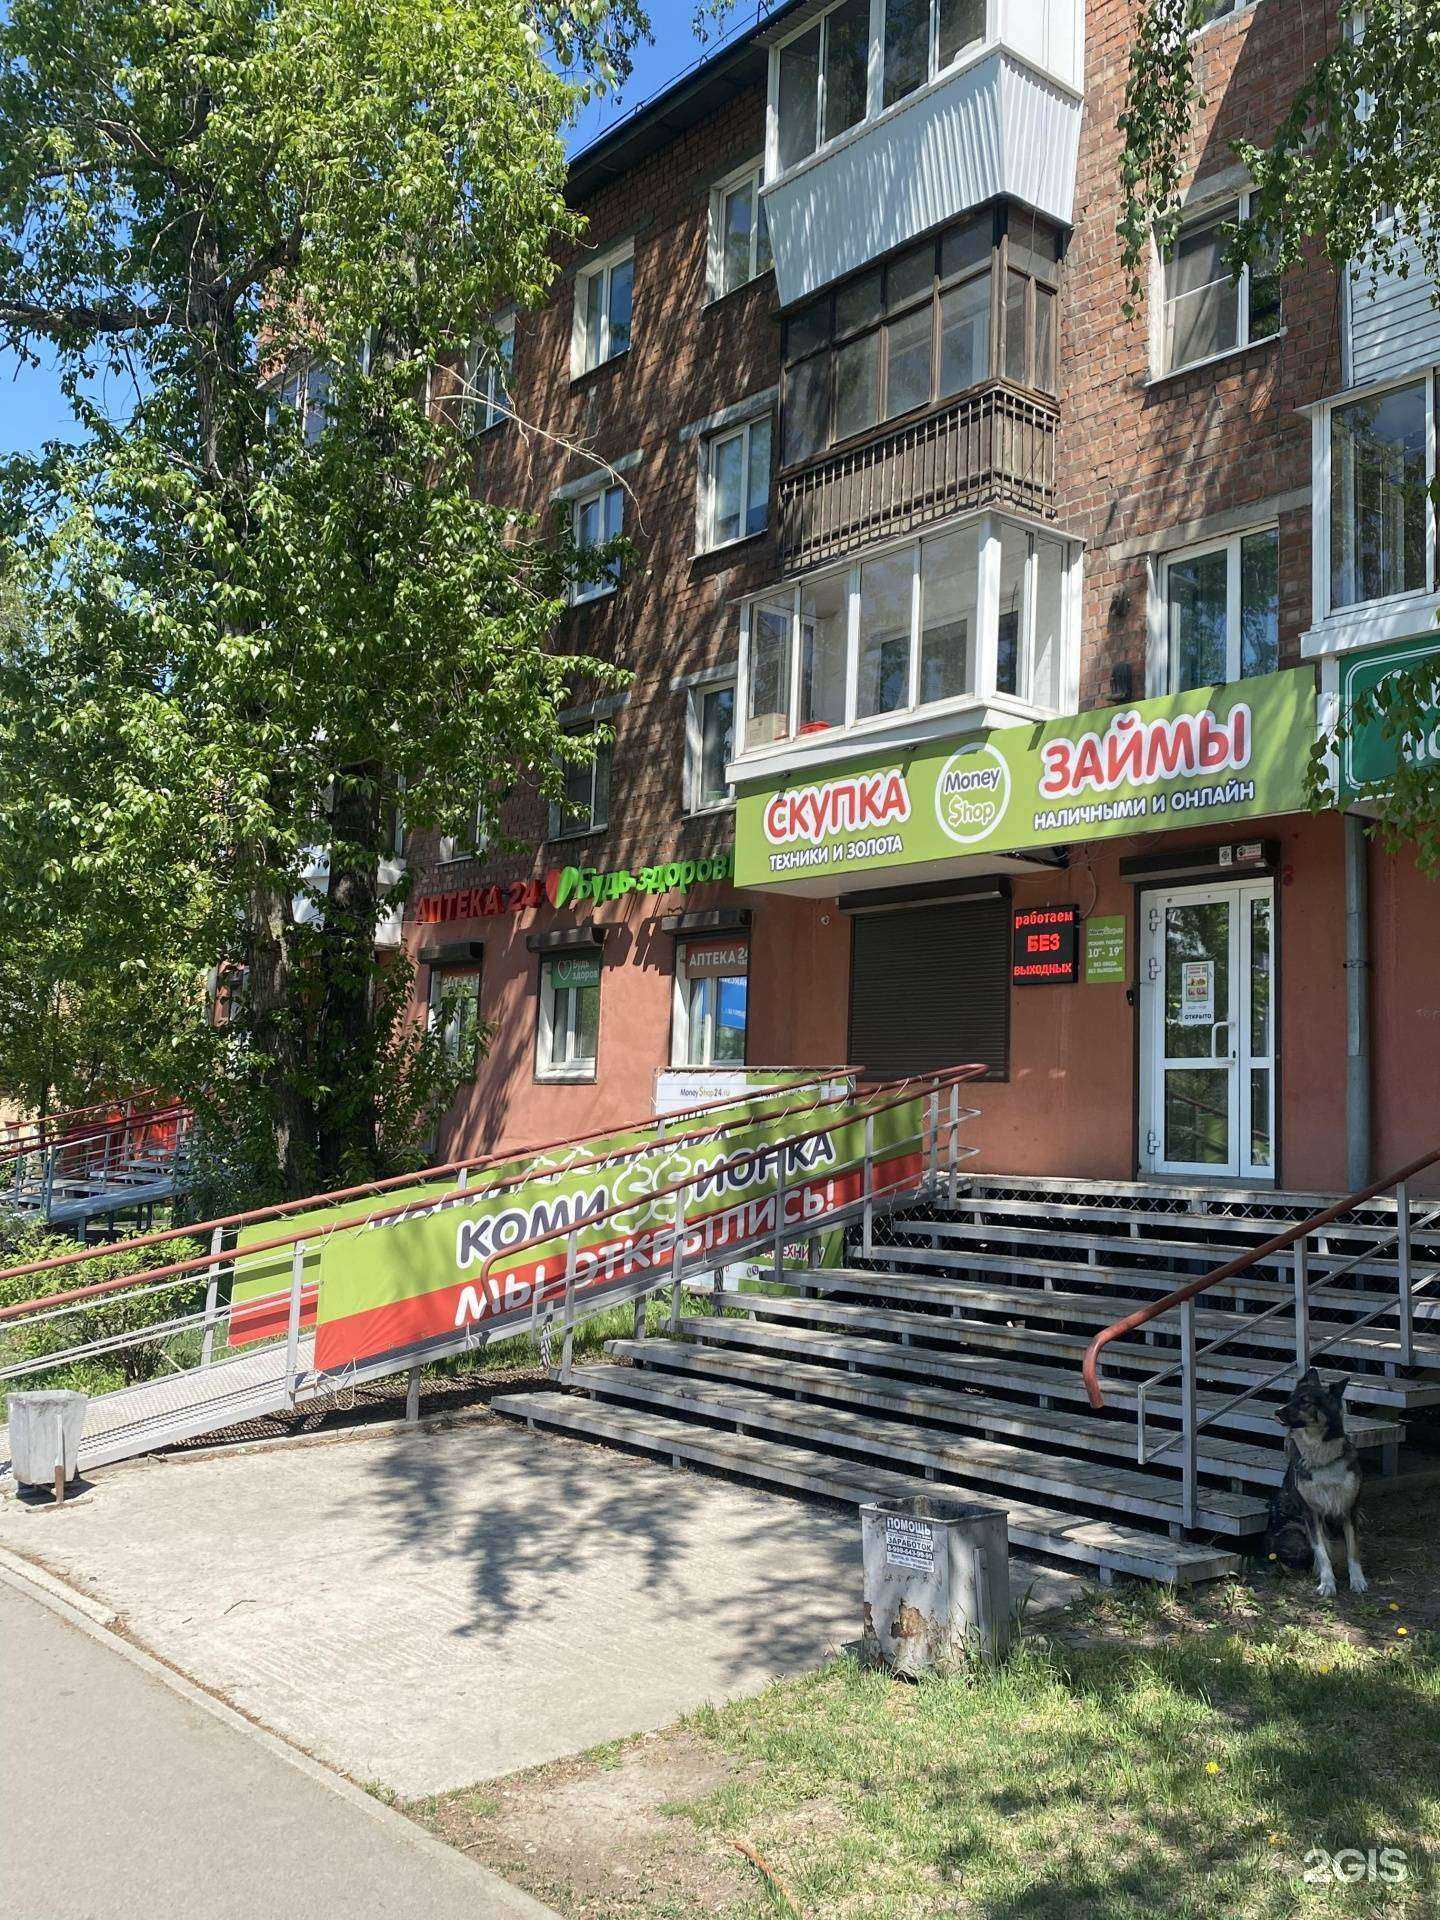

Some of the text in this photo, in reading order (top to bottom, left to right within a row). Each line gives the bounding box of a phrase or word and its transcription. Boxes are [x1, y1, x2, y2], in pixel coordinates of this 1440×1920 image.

[1041, 705, 1249, 797] ЗАЙМЫ
[944, 768, 1000, 793] Money
[765, 771, 909, 842] СКУПКА
[1034, 779, 1254, 830] НАЛИЧНЫМИ И ОНЛАЙН
[769, 835, 903, 872] ТЕХНИКИ И ЗОЛОТА
[414, 878, 543, 924] АПТЕКА 24
[1015, 911, 1074, 929] работаем
[1027, 933, 1061, 952] БЕЗ
[689, 950, 737, 967] АПТЕКА
[454, 1264, 546, 1327] МЫ
[566, 1180, 835, 1290] ОТКРЫЛИСЬ!
[887, 1517, 931, 1536] ПОМОЩЬ
[887, 1536, 931, 1553] ЗАРАБОТОК
